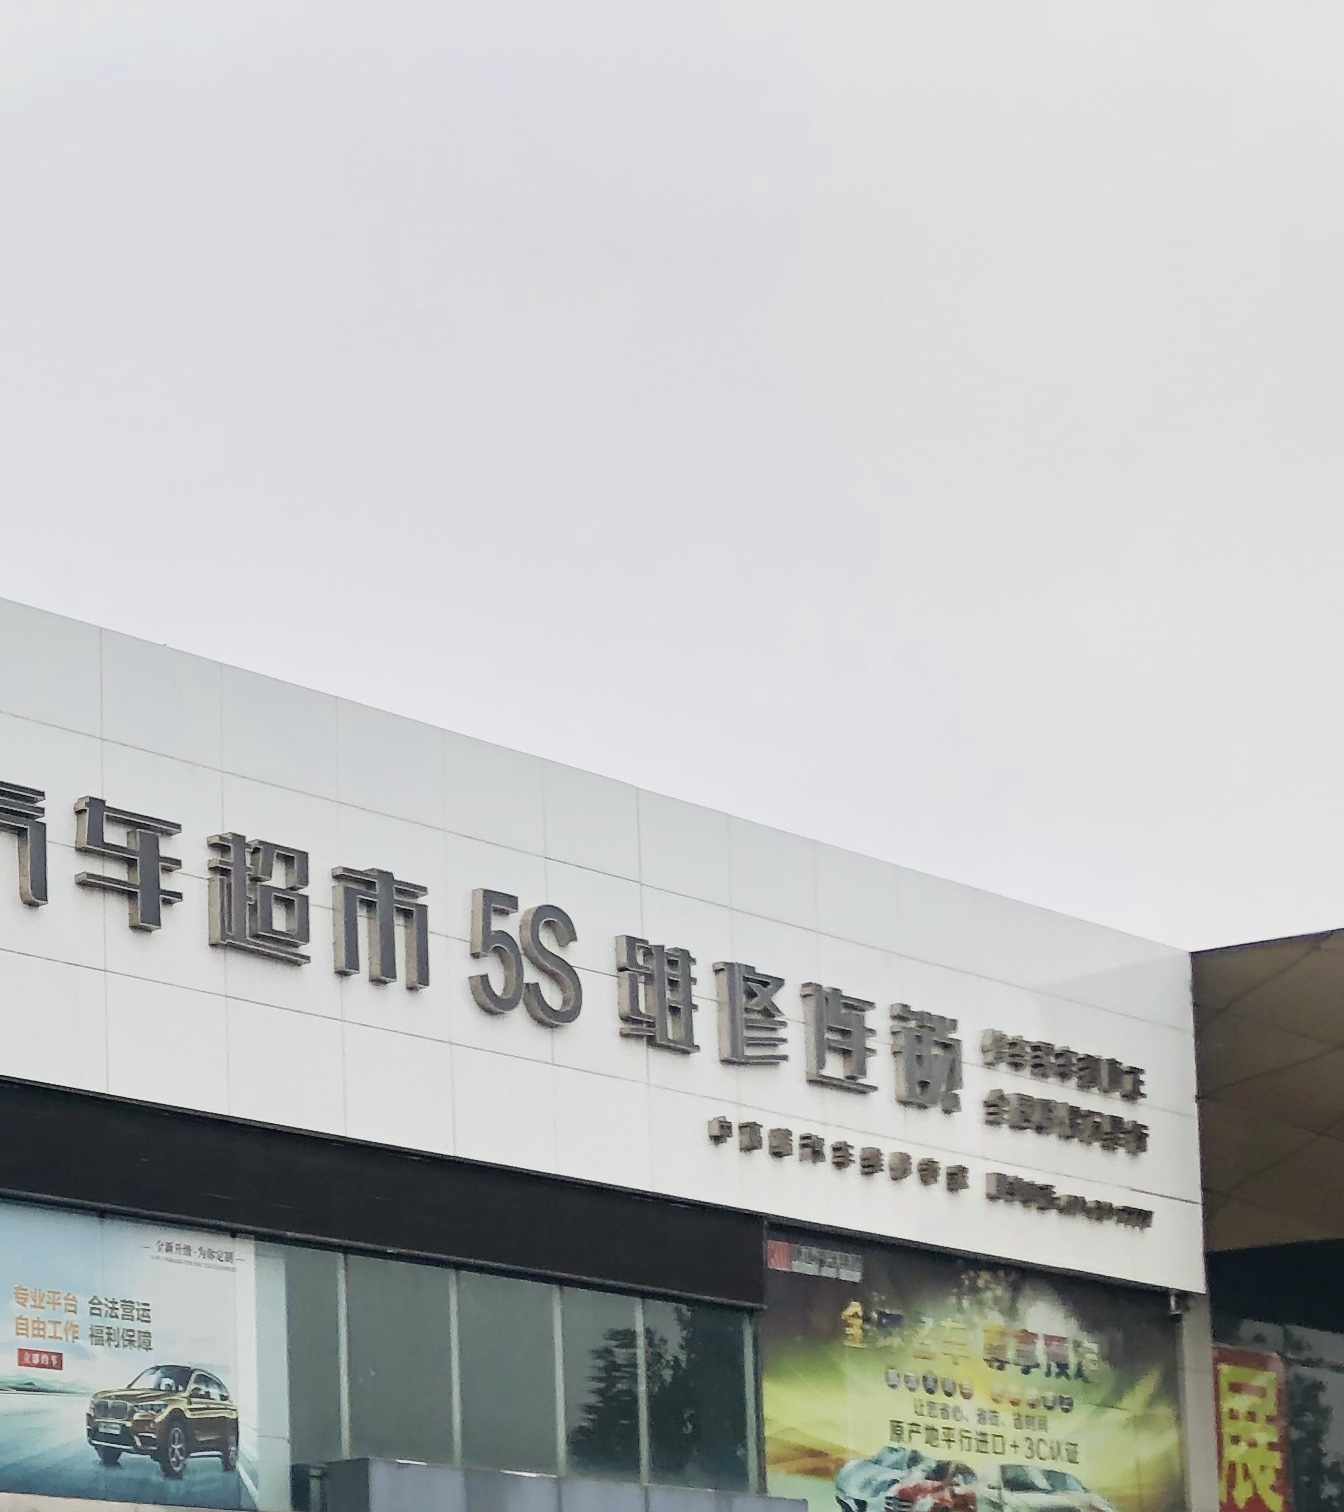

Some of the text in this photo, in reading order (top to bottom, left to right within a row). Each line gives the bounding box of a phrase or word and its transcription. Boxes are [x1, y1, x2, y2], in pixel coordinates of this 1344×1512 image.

[13, 1284, 152, 1324] 专业平台 合法营运
[15, 1315, 154, 1352] 自由工作 福利保障
